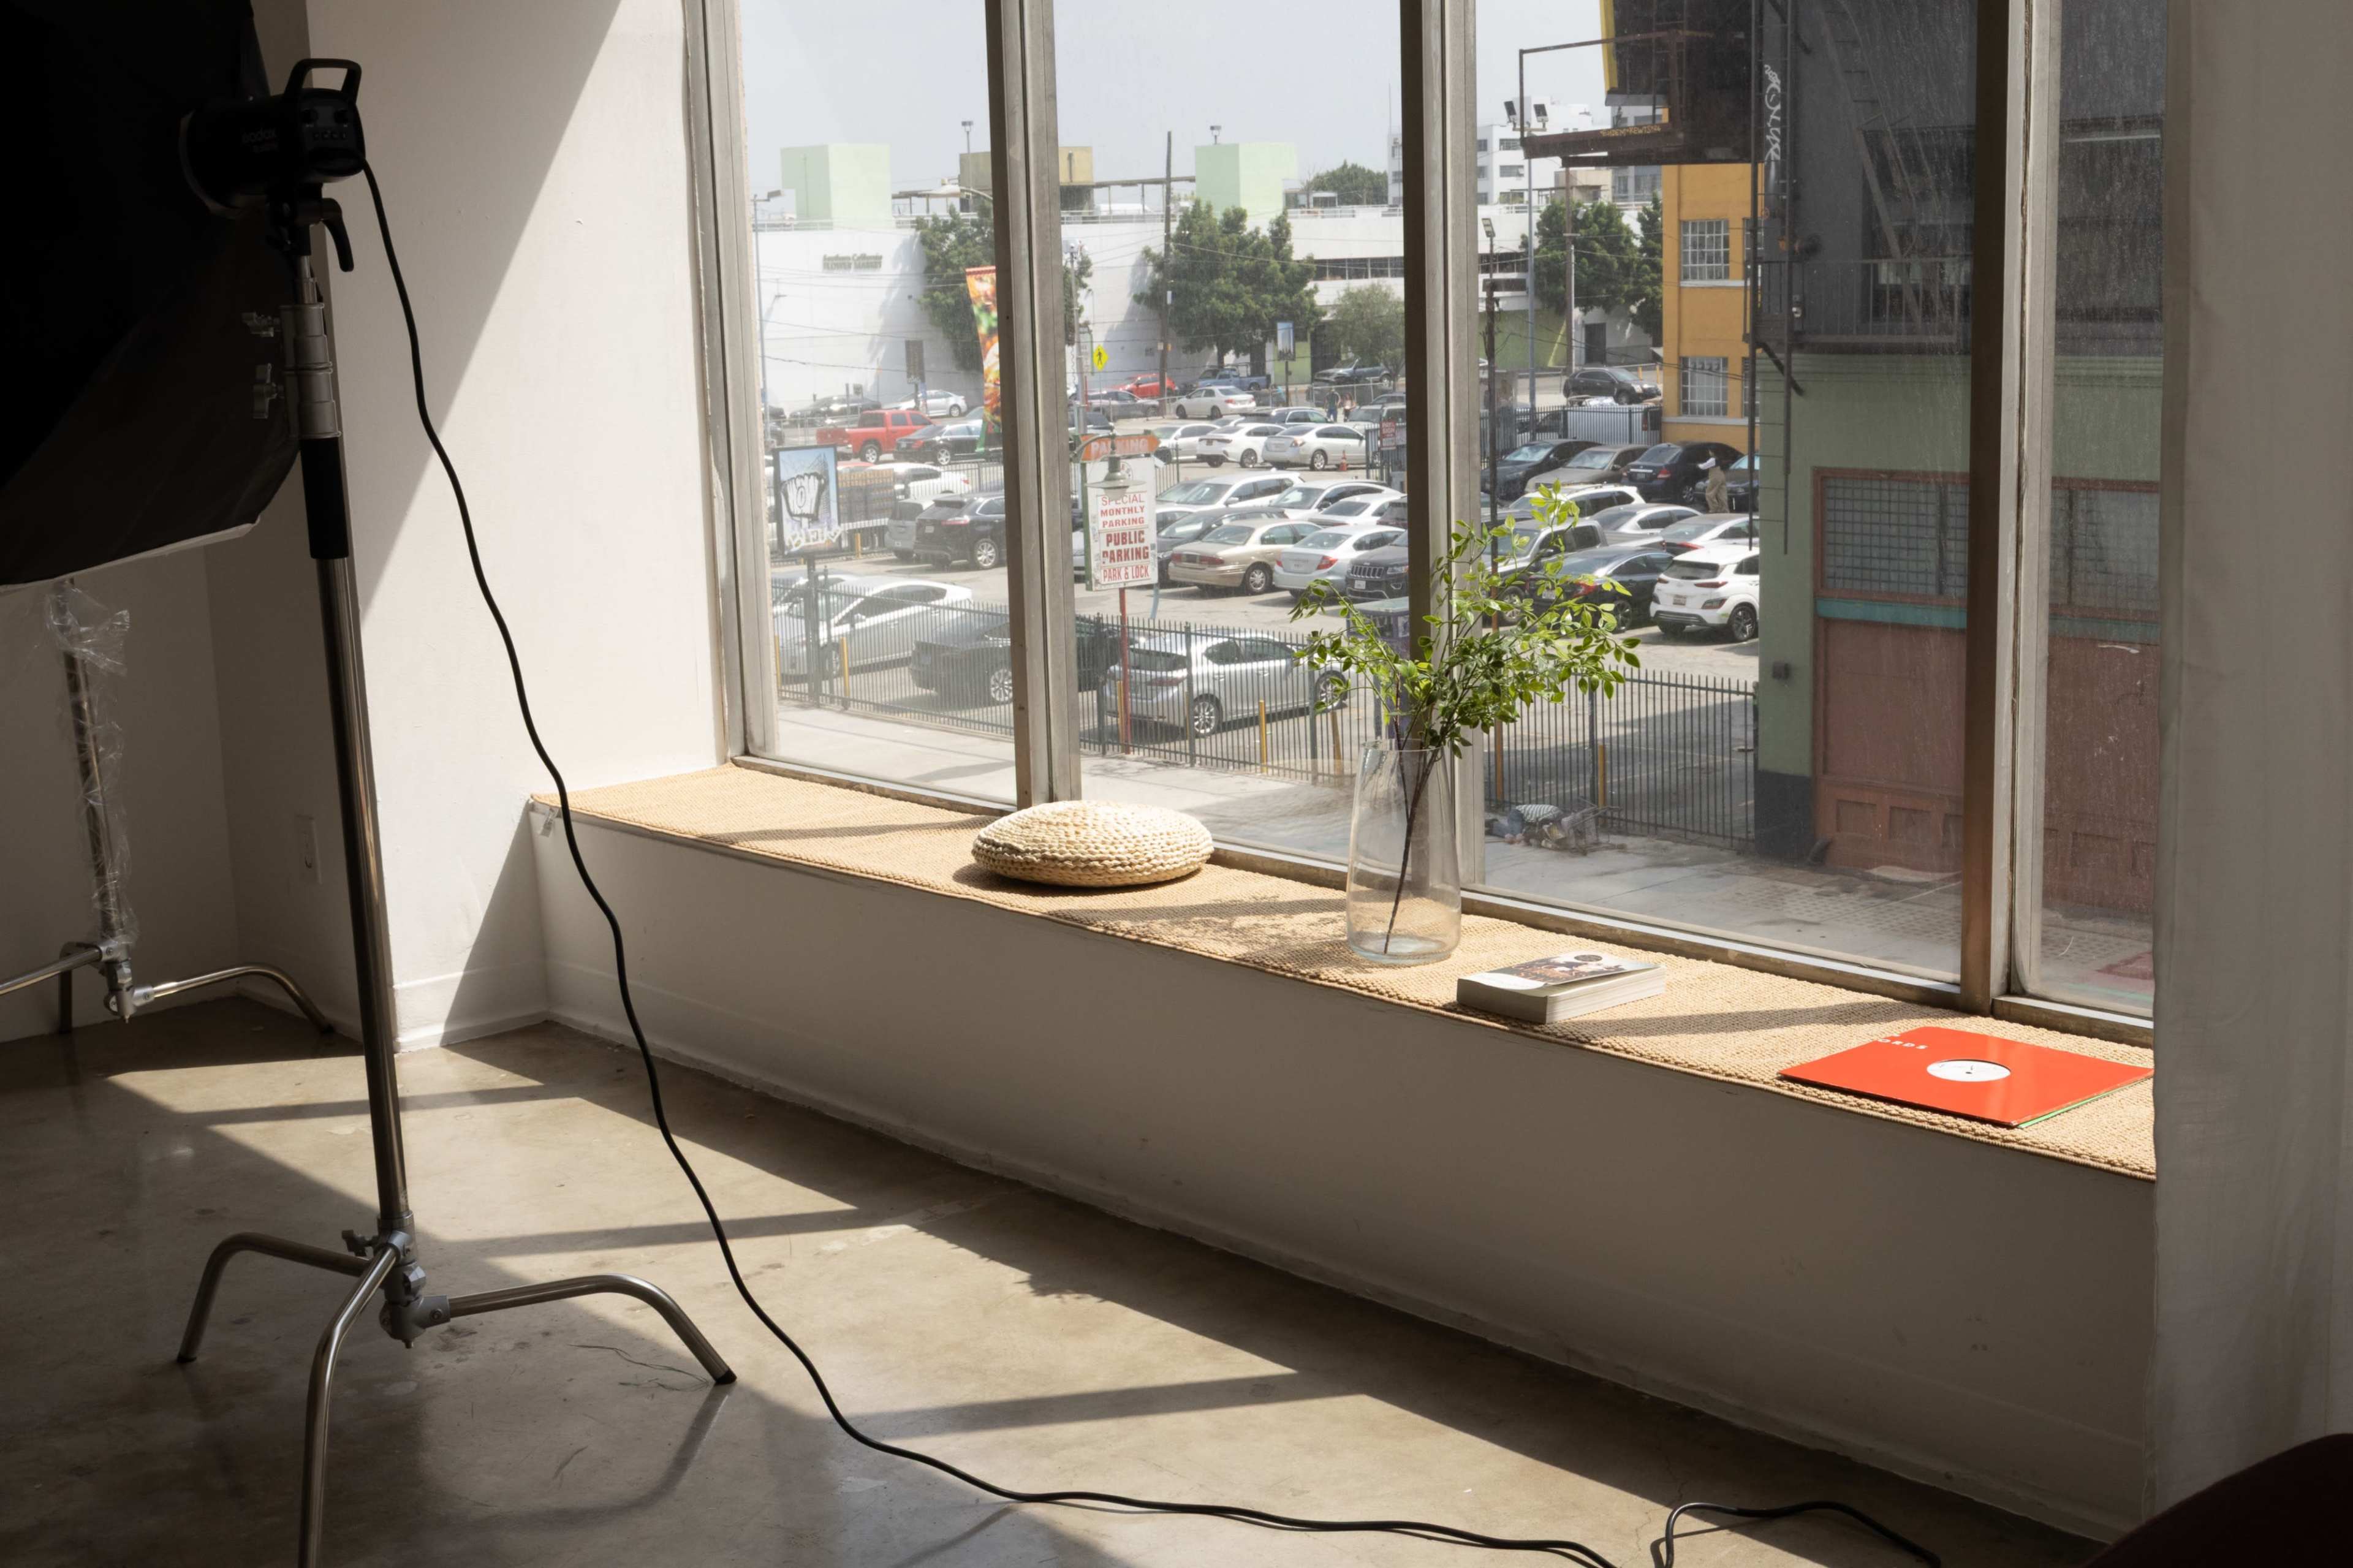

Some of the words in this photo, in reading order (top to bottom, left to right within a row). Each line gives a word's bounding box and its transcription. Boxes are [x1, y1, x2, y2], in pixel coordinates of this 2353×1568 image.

[1091, 439, 1148, 458] PAKING
[1101, 506, 1145, 518] MONTHLY
[1102, 517, 1145, 528] PARKING
[1106, 530, 1145, 547] PUBLIC
[1102, 546, 1149, 564] PARKING
[1104, 568, 1122, 582] PARK
[1124, 567, 1129, 580] &
[1132, 565, 1149, 579] LOCK
